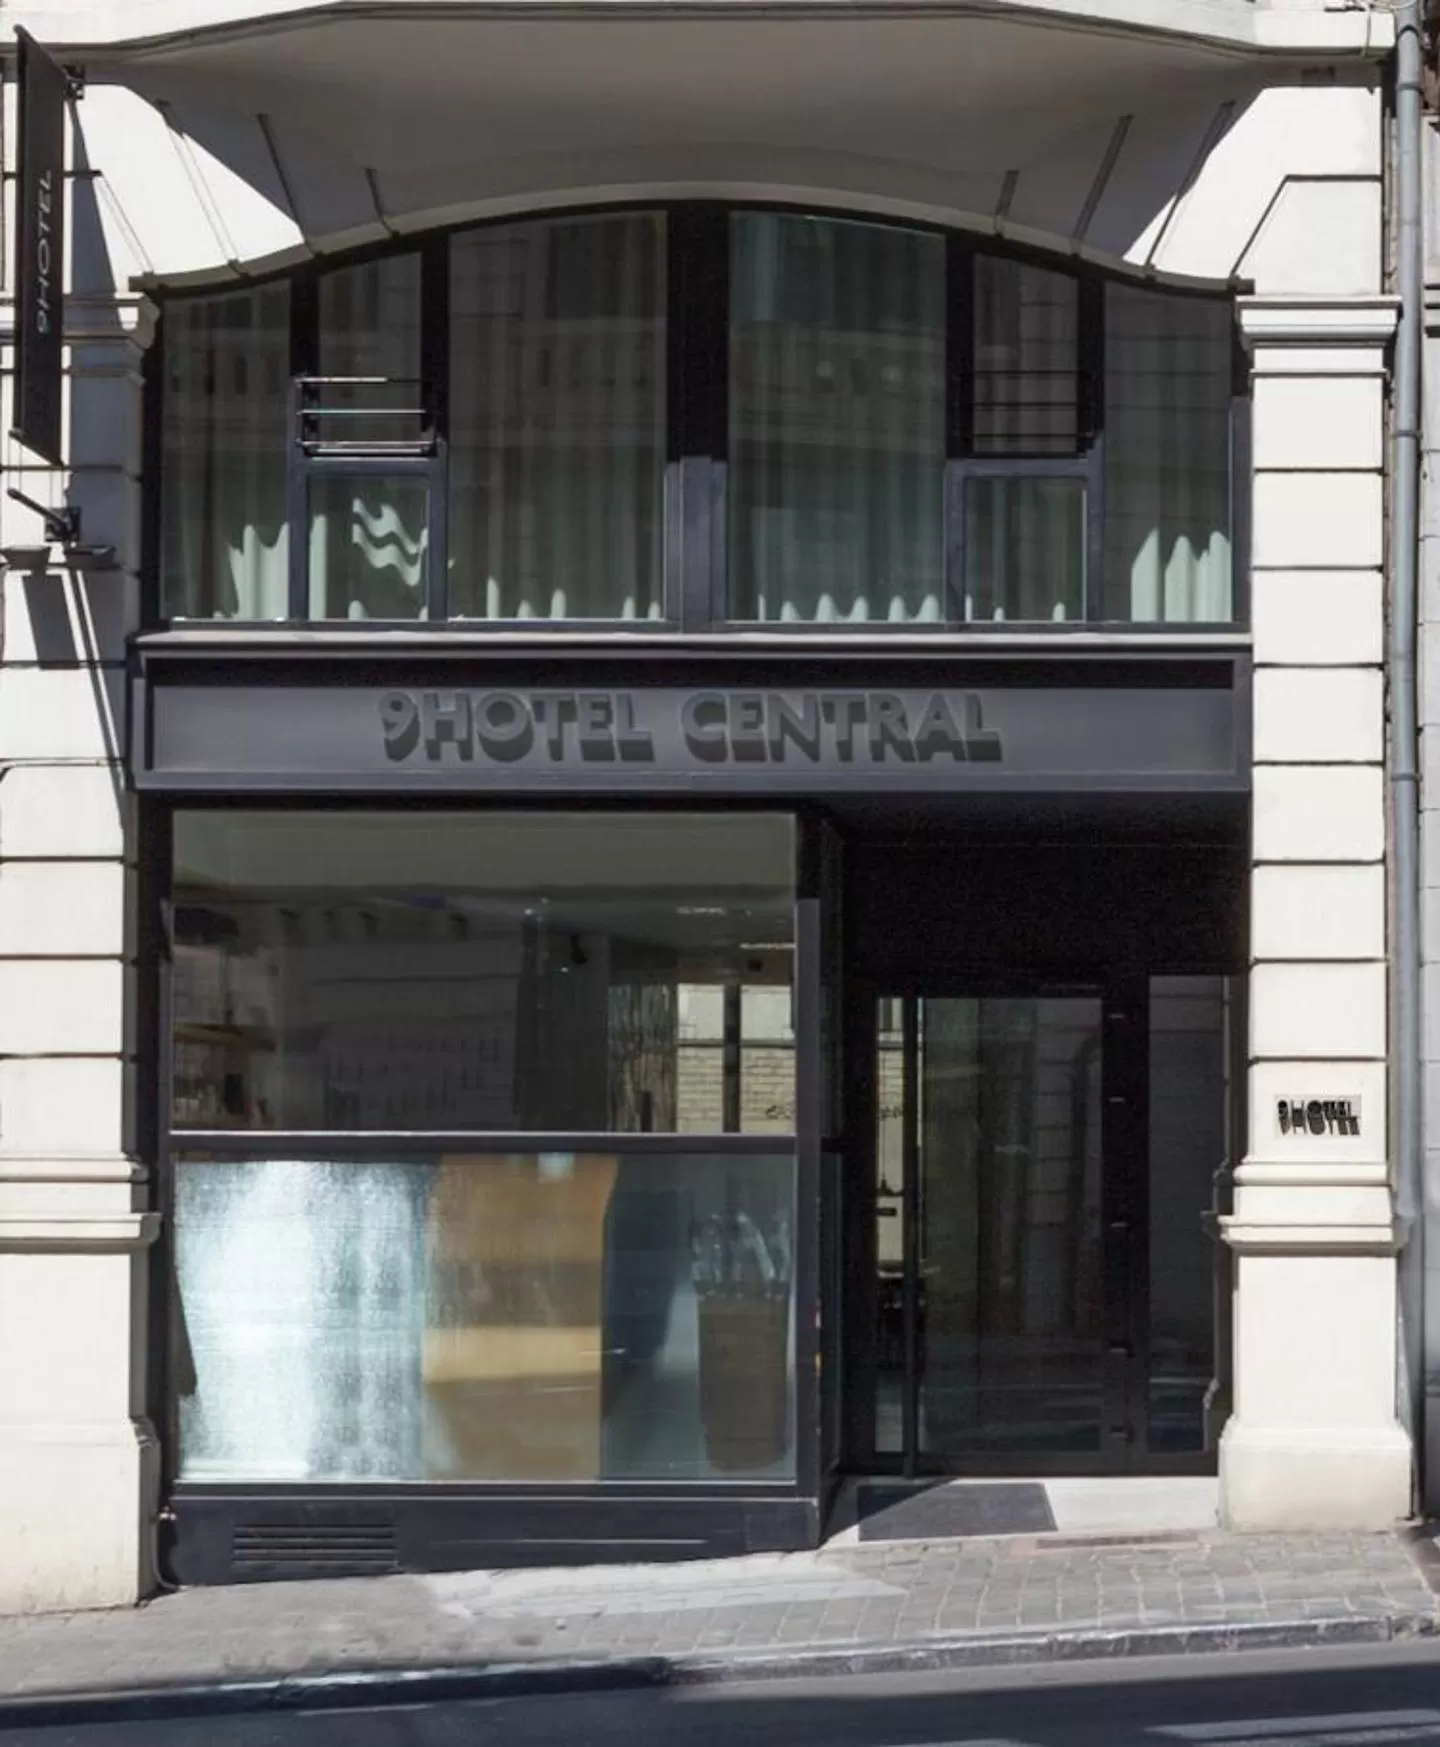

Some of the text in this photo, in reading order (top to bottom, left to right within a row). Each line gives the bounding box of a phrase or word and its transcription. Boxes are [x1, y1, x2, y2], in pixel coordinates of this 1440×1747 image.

[36, 170, 51, 334] 9HOTEL
[377, 691, 1001, 743] 9HOTEL CENTRAL
[1278, 1099, 1357, 1131] 9HOTEL
